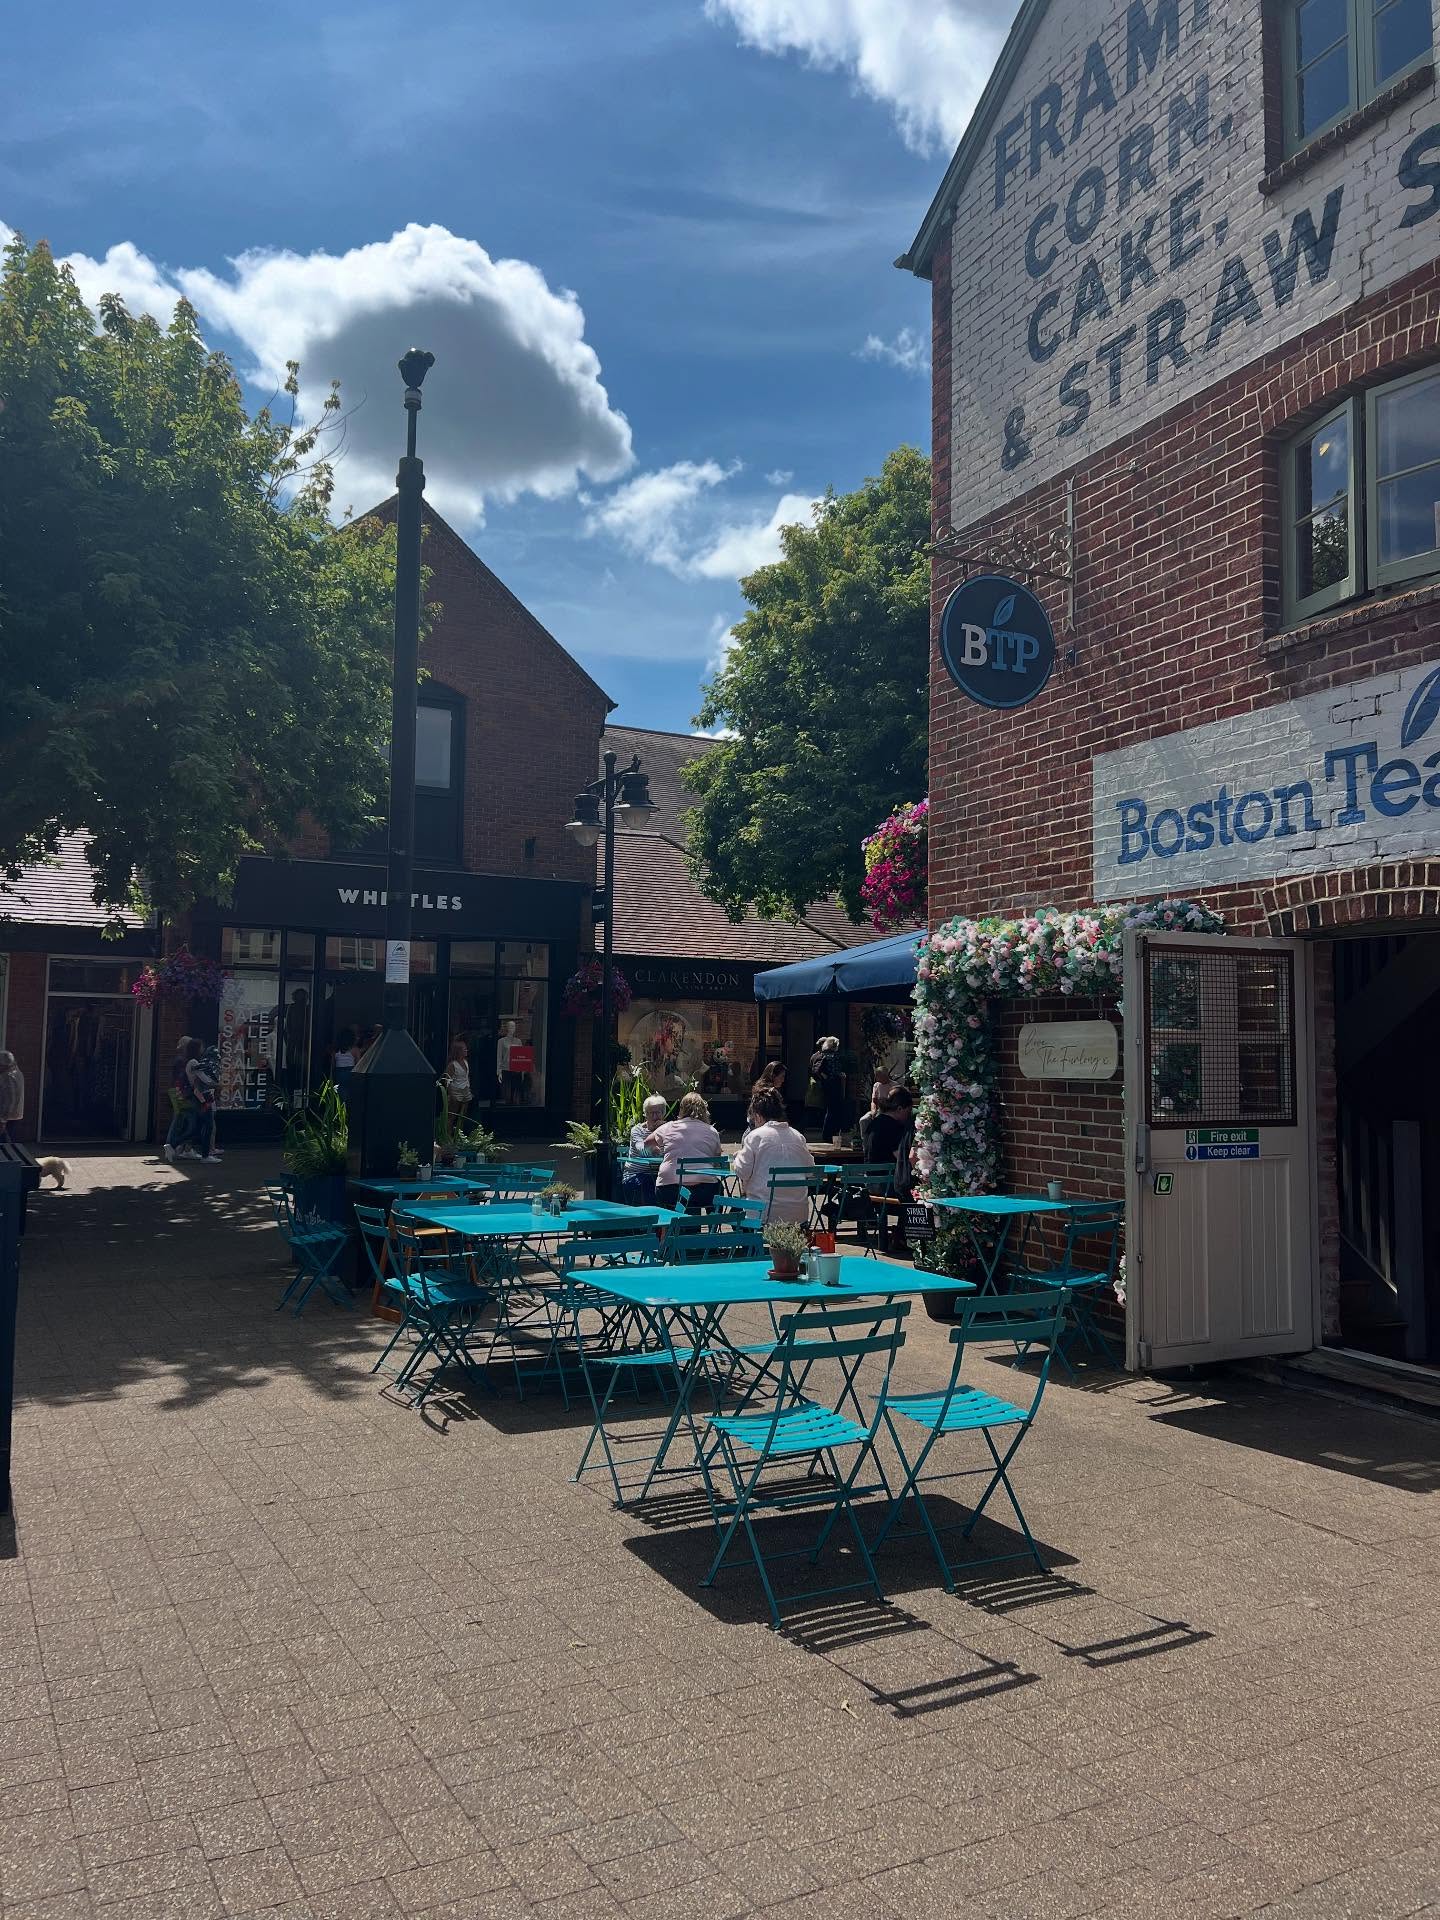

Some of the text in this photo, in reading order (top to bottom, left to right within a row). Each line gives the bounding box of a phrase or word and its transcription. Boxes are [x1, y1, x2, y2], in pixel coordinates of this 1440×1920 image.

[994, 0, 1210, 209] FRAM
[1027, 179, 1229, 363] CAKE,
[1002, 406, 1033, 472] &
[1056, 184, 1345, 438] STRAW
[960, 622, 1040, 674] BTP
[1116, 781, 1322, 866] Boston
[338, 888, 462, 910] WHITLES
[635, 969, 739, 988] CLARENDON
[224, 1009, 269, 1023] SALE
[220, 1057, 267, 1069] SAL
[1039, 1046, 1057, 1072] The
[219, 1088, 266, 1101] SALE
[1210, 1130, 1248, 1142] Fire exit
[1207, 1145, 1251, 1158] Keep clear
